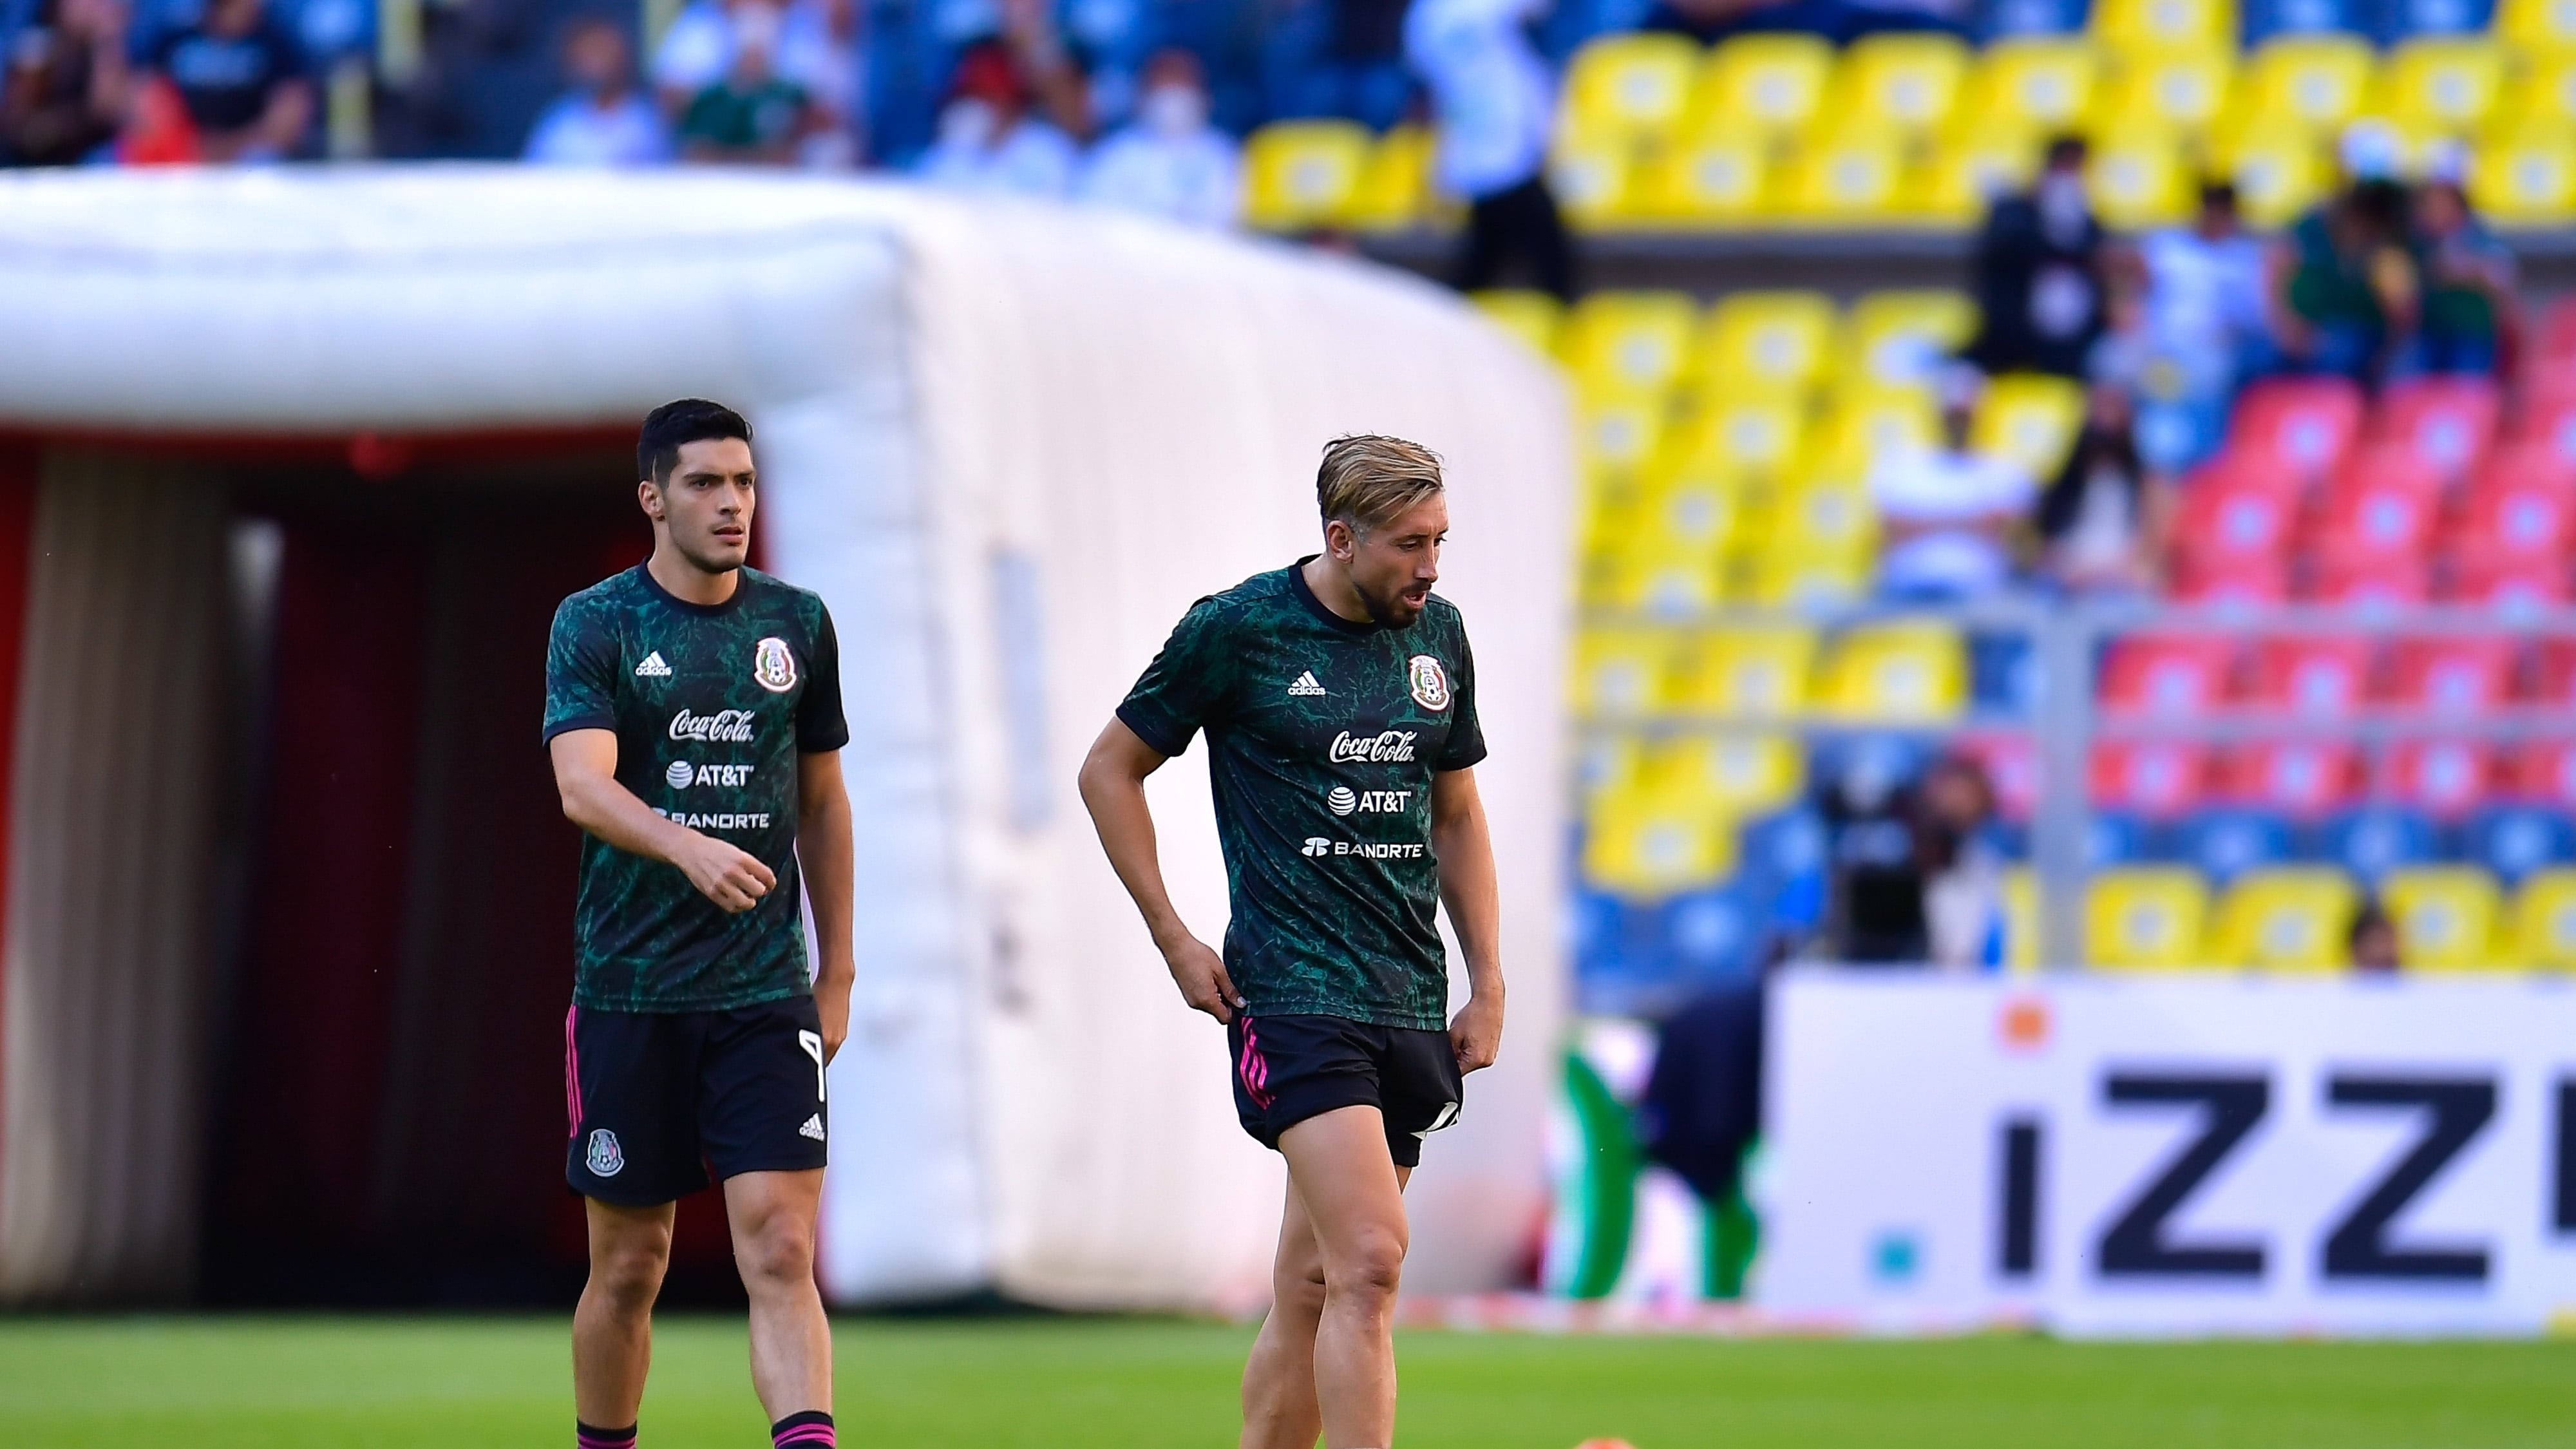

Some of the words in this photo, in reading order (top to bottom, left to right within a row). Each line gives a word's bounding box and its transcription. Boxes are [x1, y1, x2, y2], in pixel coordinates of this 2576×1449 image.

[635, 666, 672, 676] adidas
[1287, 686, 1326, 696] adidas
[695, 764, 749, 787] AT&T
[1358, 790, 1410, 813] AT&T
[671, 812, 770, 829] BANORTE
[1334, 840, 1424, 859] BANORTE
